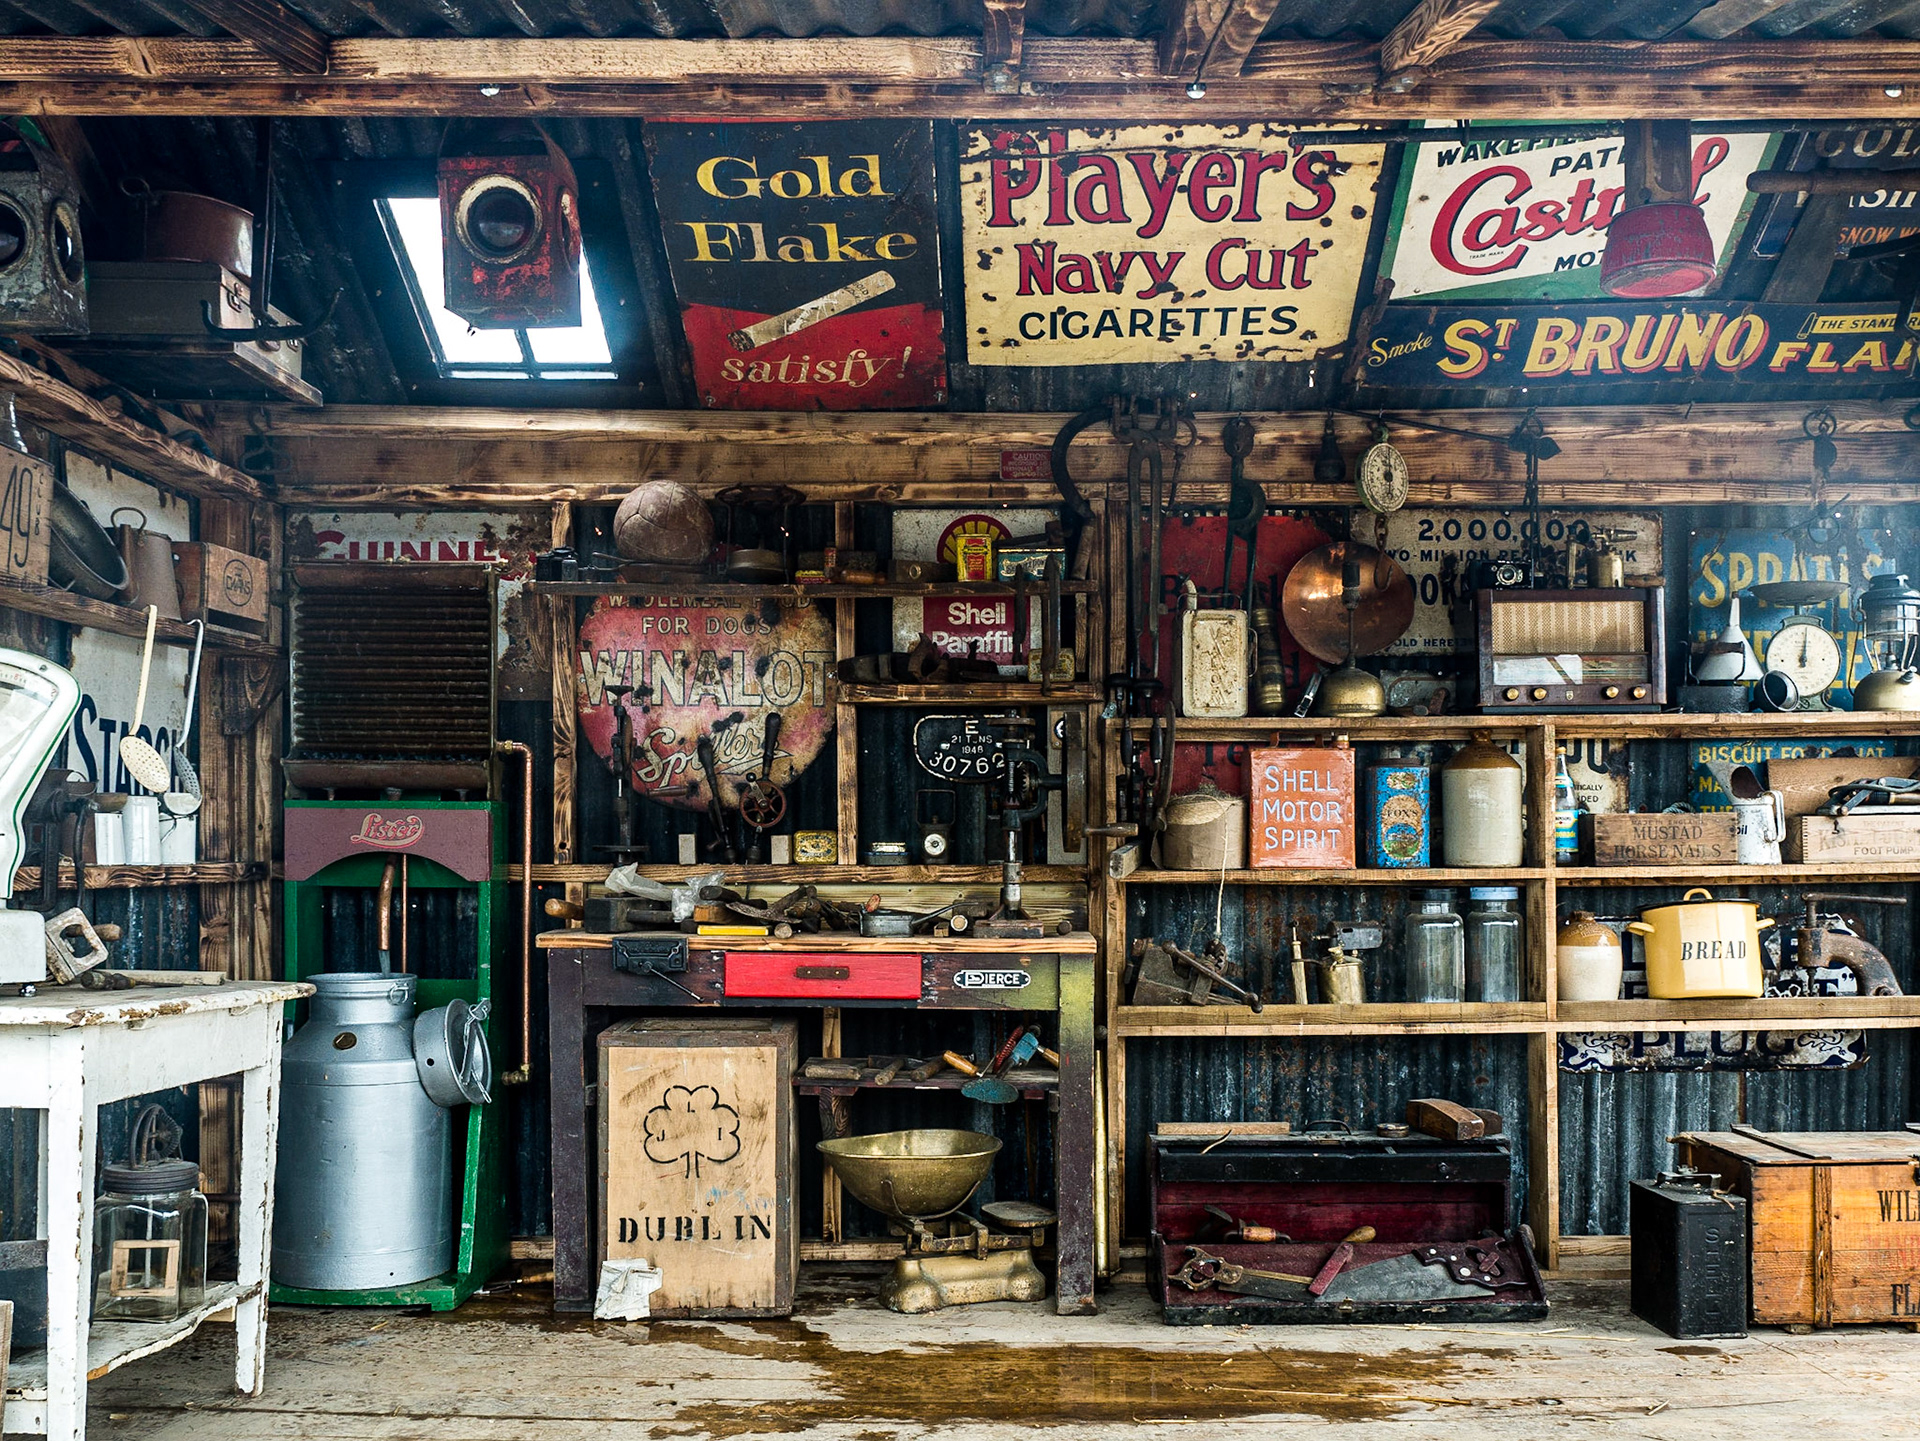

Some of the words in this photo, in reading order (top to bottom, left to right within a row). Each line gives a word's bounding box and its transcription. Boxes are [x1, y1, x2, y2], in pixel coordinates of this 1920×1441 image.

[696, 154, 895, 200] Gold
[986, 131, 1338, 240] Player's
[675, 221, 919, 263] Flake
[1015, 238, 1187, 299] Navy
[1204, 237, 1319, 292] Cut
[1018, 306, 1299, 341] CIGARETTES
[1820, 320, 1847, 330] THE
[1367, 331, 1434, 368] Smoke
[1521, 311, 1771, 379] BRUNO
[0, 464, 34, 574] 49
[641, 617, 691, 636] FOR
[706, 616, 773, 636] DOGS
[948, 602, 1006, 626] Shell
[579, 649, 837, 709] WINALOT
[951, 735, 962, 744] 21
[966, 734, 993, 744] TNS
[965, 720, 979, 734] E
[1699, 746, 1775, 764] BISCUIT
[1265, 765, 1339, 793] SHELL
[1263, 799, 1342, 823] MOTOR
[1387, 809, 1418, 818] FOX'S
[350, 812, 426, 849] Lister
[1265, 827, 1340, 850] SPIRIT
[1633, 826, 1703, 841] MUSTAD
[1614, 844, 1668, 859] HORSE
[1854, 847, 1883, 856] FOOT
[1885, 846, 1915, 856] PUMP
[1680, 939, 1747, 961] BREAD
[964, 971, 1021, 987] PIERCE
[1632, 1031, 1796, 1058] PLUG
[618, 1214, 771, 1243] DUBLIN
